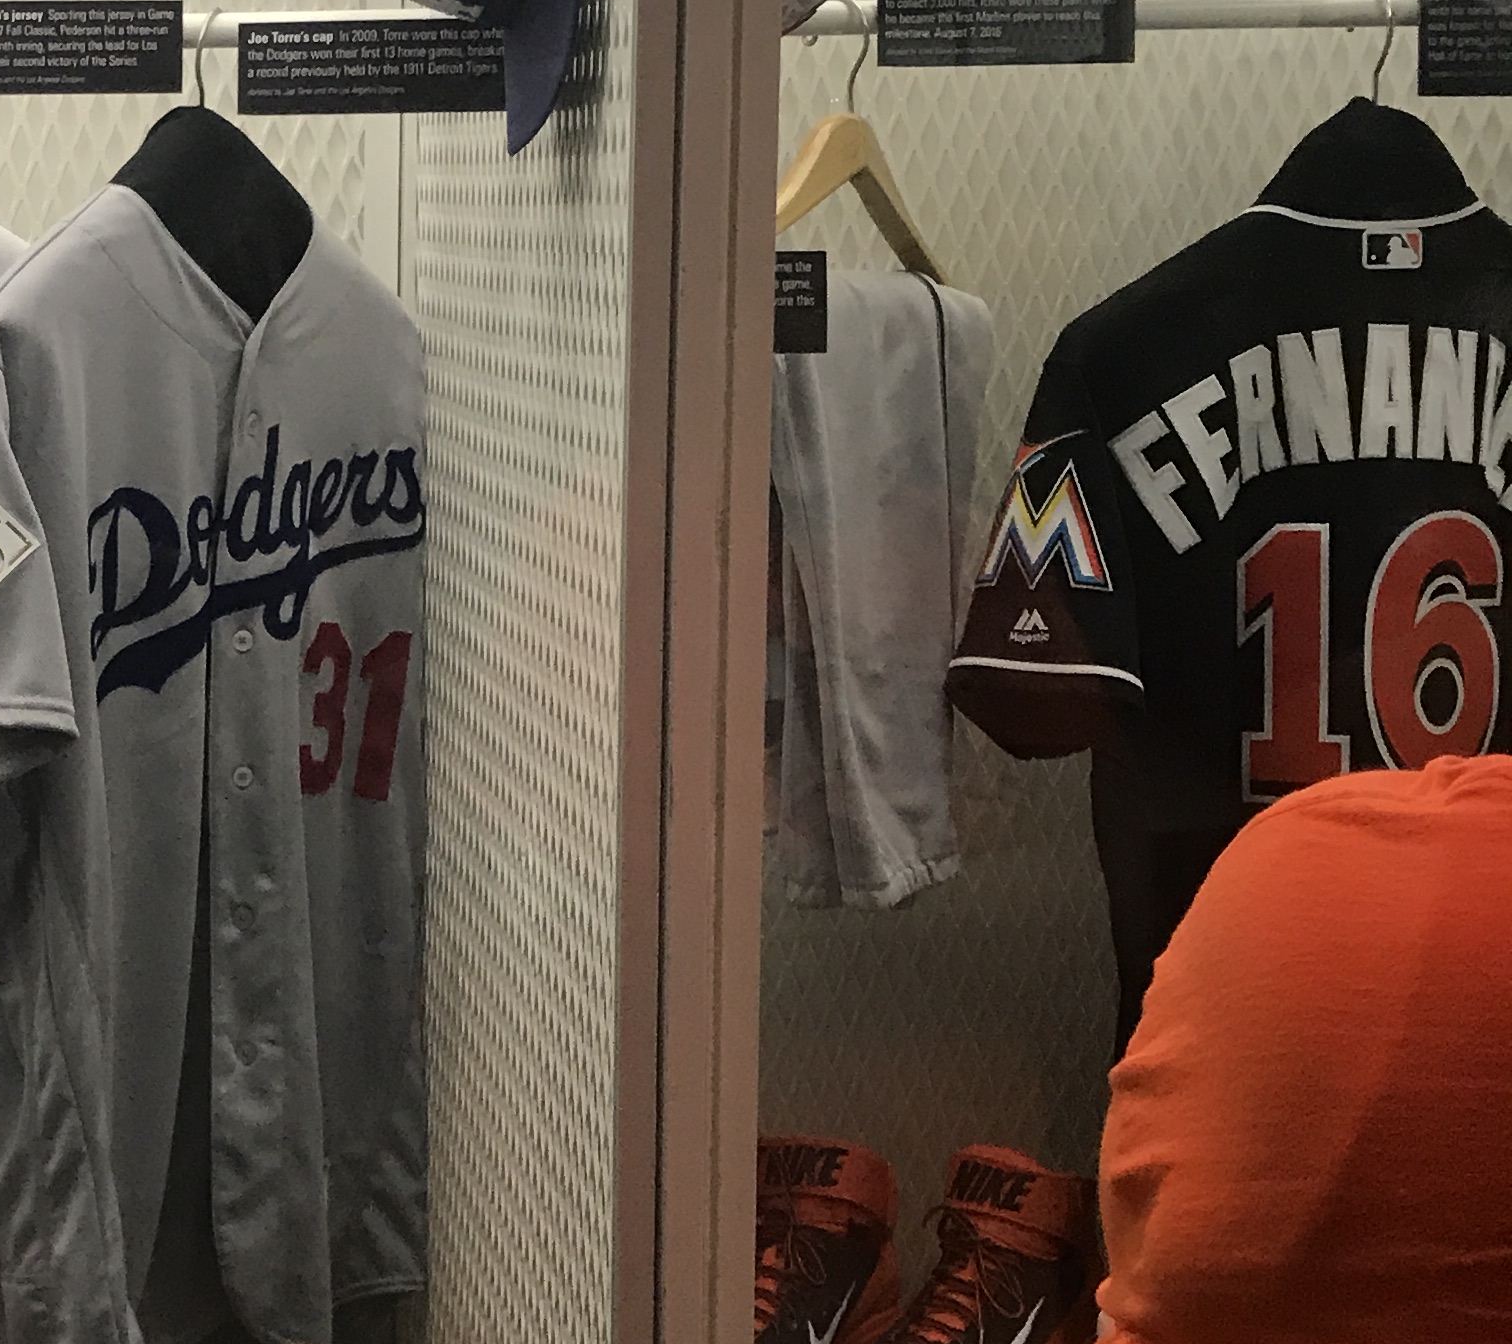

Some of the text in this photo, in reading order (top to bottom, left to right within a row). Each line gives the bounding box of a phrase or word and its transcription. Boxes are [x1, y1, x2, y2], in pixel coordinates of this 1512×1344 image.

[248, 32, 333, 44] Joe Torre's cap
[88, 425, 427, 707] Dodgers
[1237, 510, 1504, 802] 16
[299, 622, 412, 802] 31
[951, 1160, 1038, 1213] NIKE
